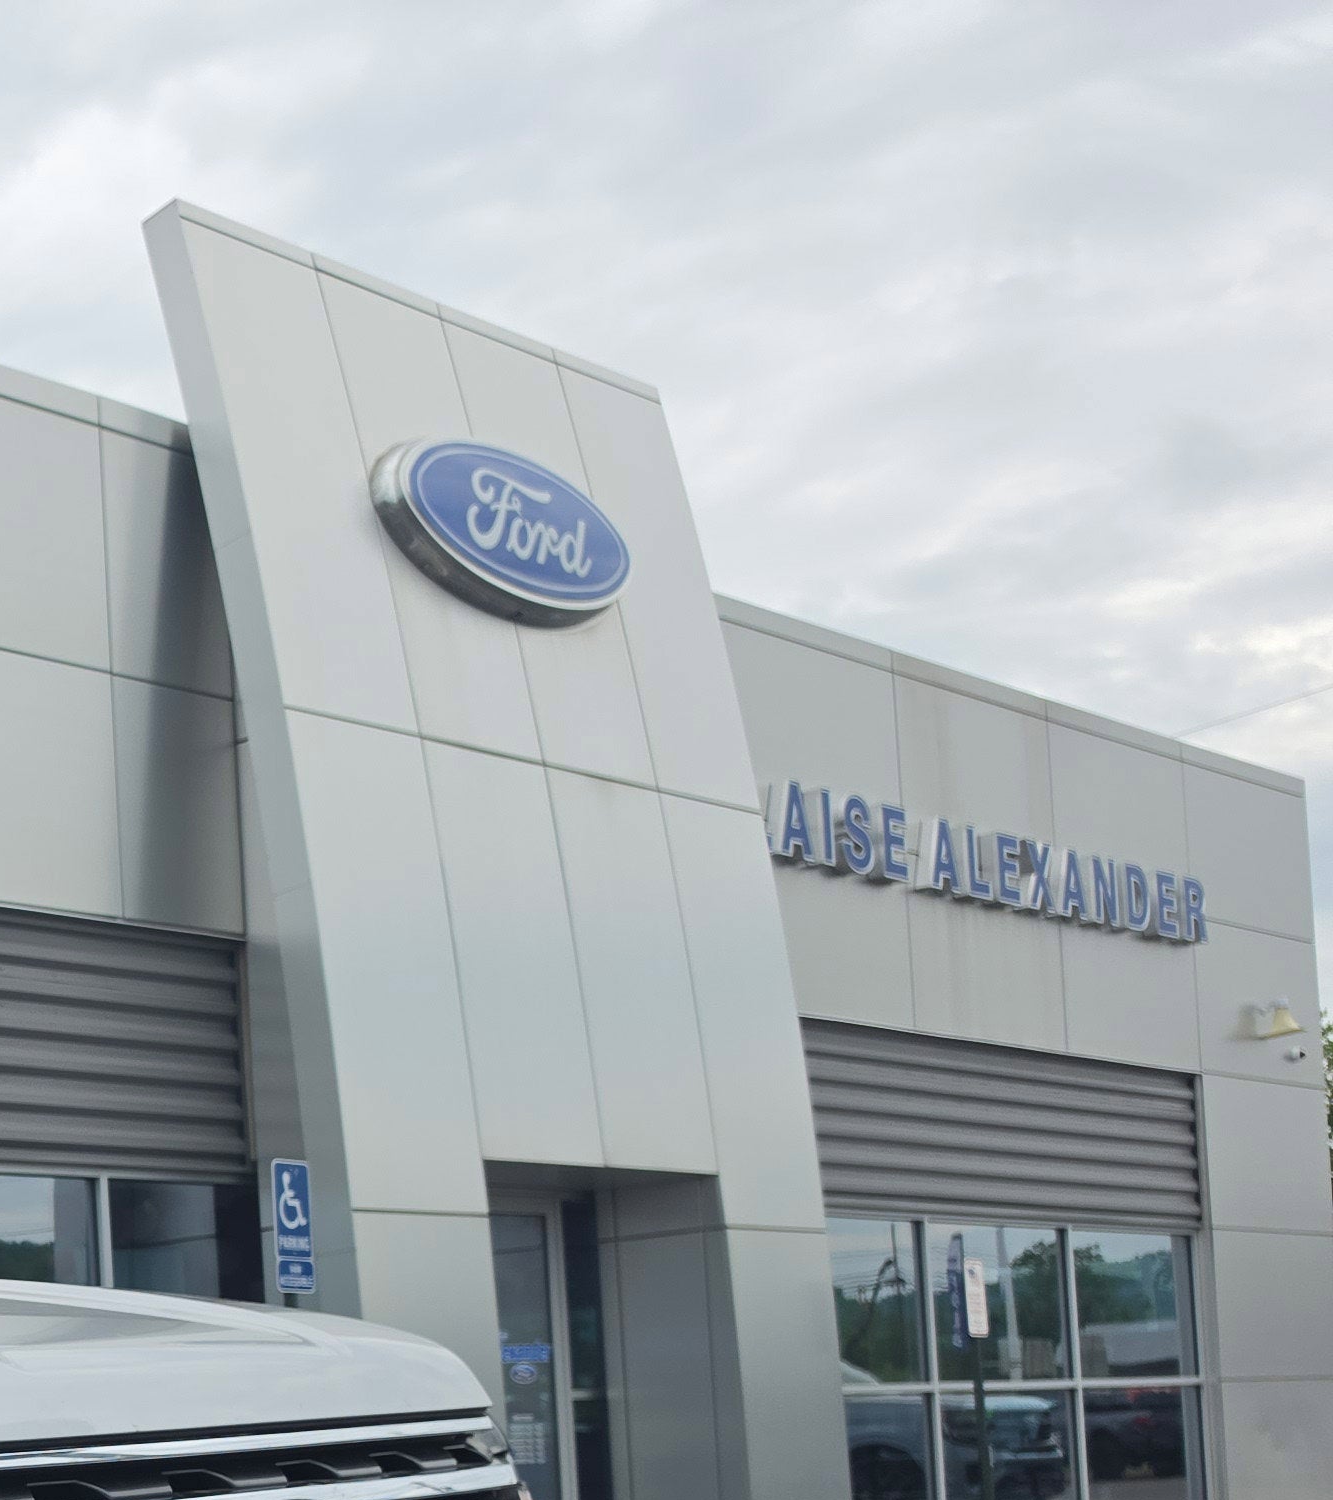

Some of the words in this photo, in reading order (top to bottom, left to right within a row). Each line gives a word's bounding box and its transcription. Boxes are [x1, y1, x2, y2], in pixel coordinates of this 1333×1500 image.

[466, 466, 593, 578] Ford
[767, 779, 910, 884] AISE
[930, 814, 1209, 945] ALEXANDER
